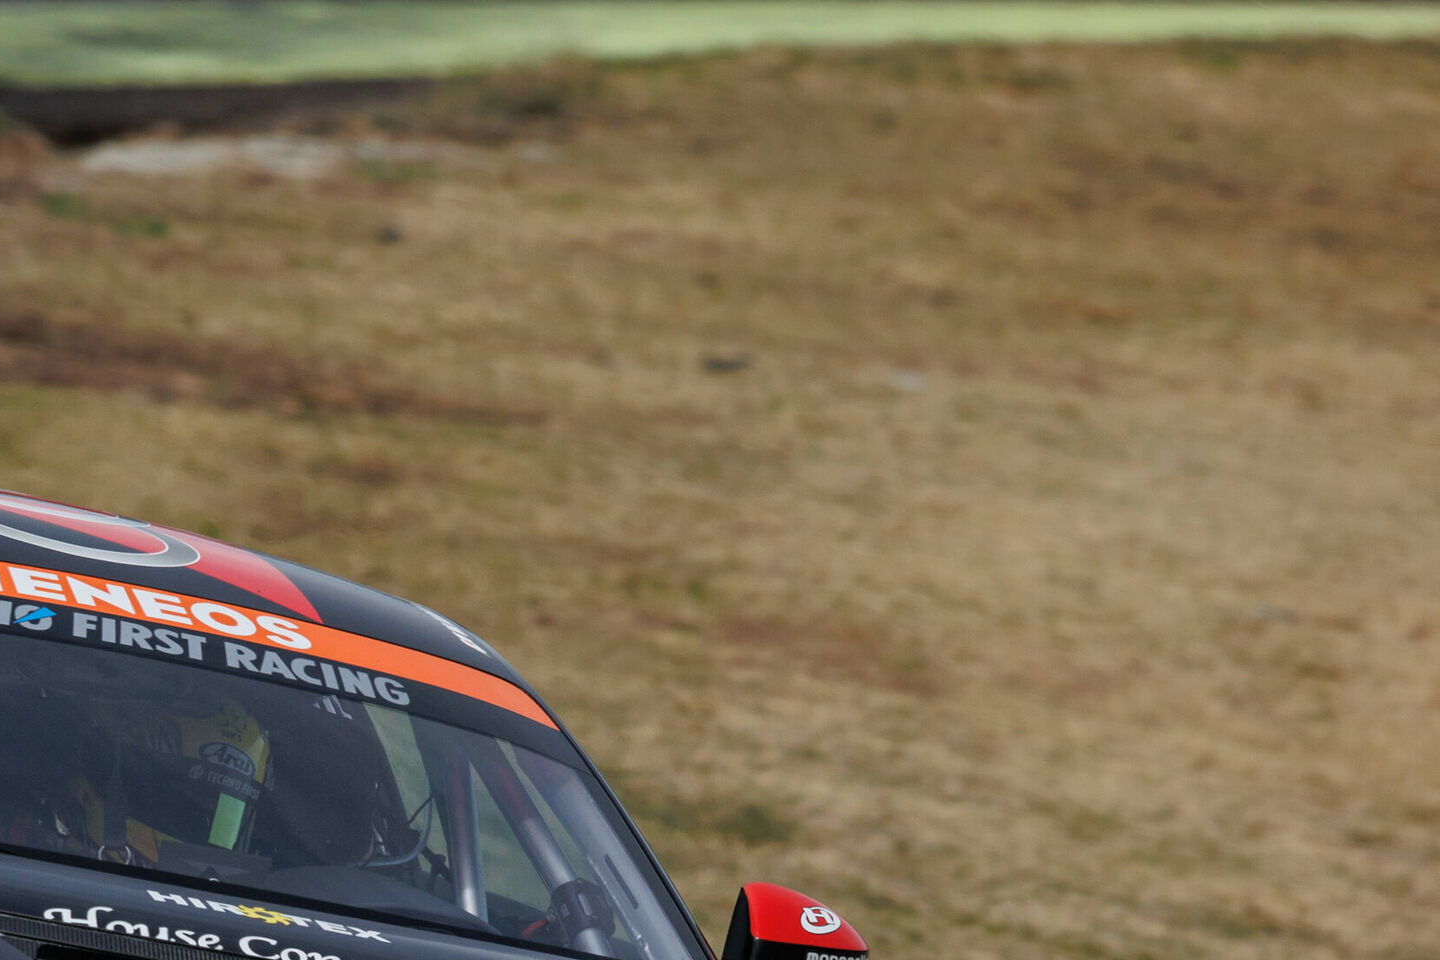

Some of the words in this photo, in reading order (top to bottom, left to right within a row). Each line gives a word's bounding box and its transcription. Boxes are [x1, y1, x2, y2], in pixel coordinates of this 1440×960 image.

[7, 566, 312, 650] ENEOS
[72, 612, 207, 661] FIRST
[224, 641, 410, 706] RACING
